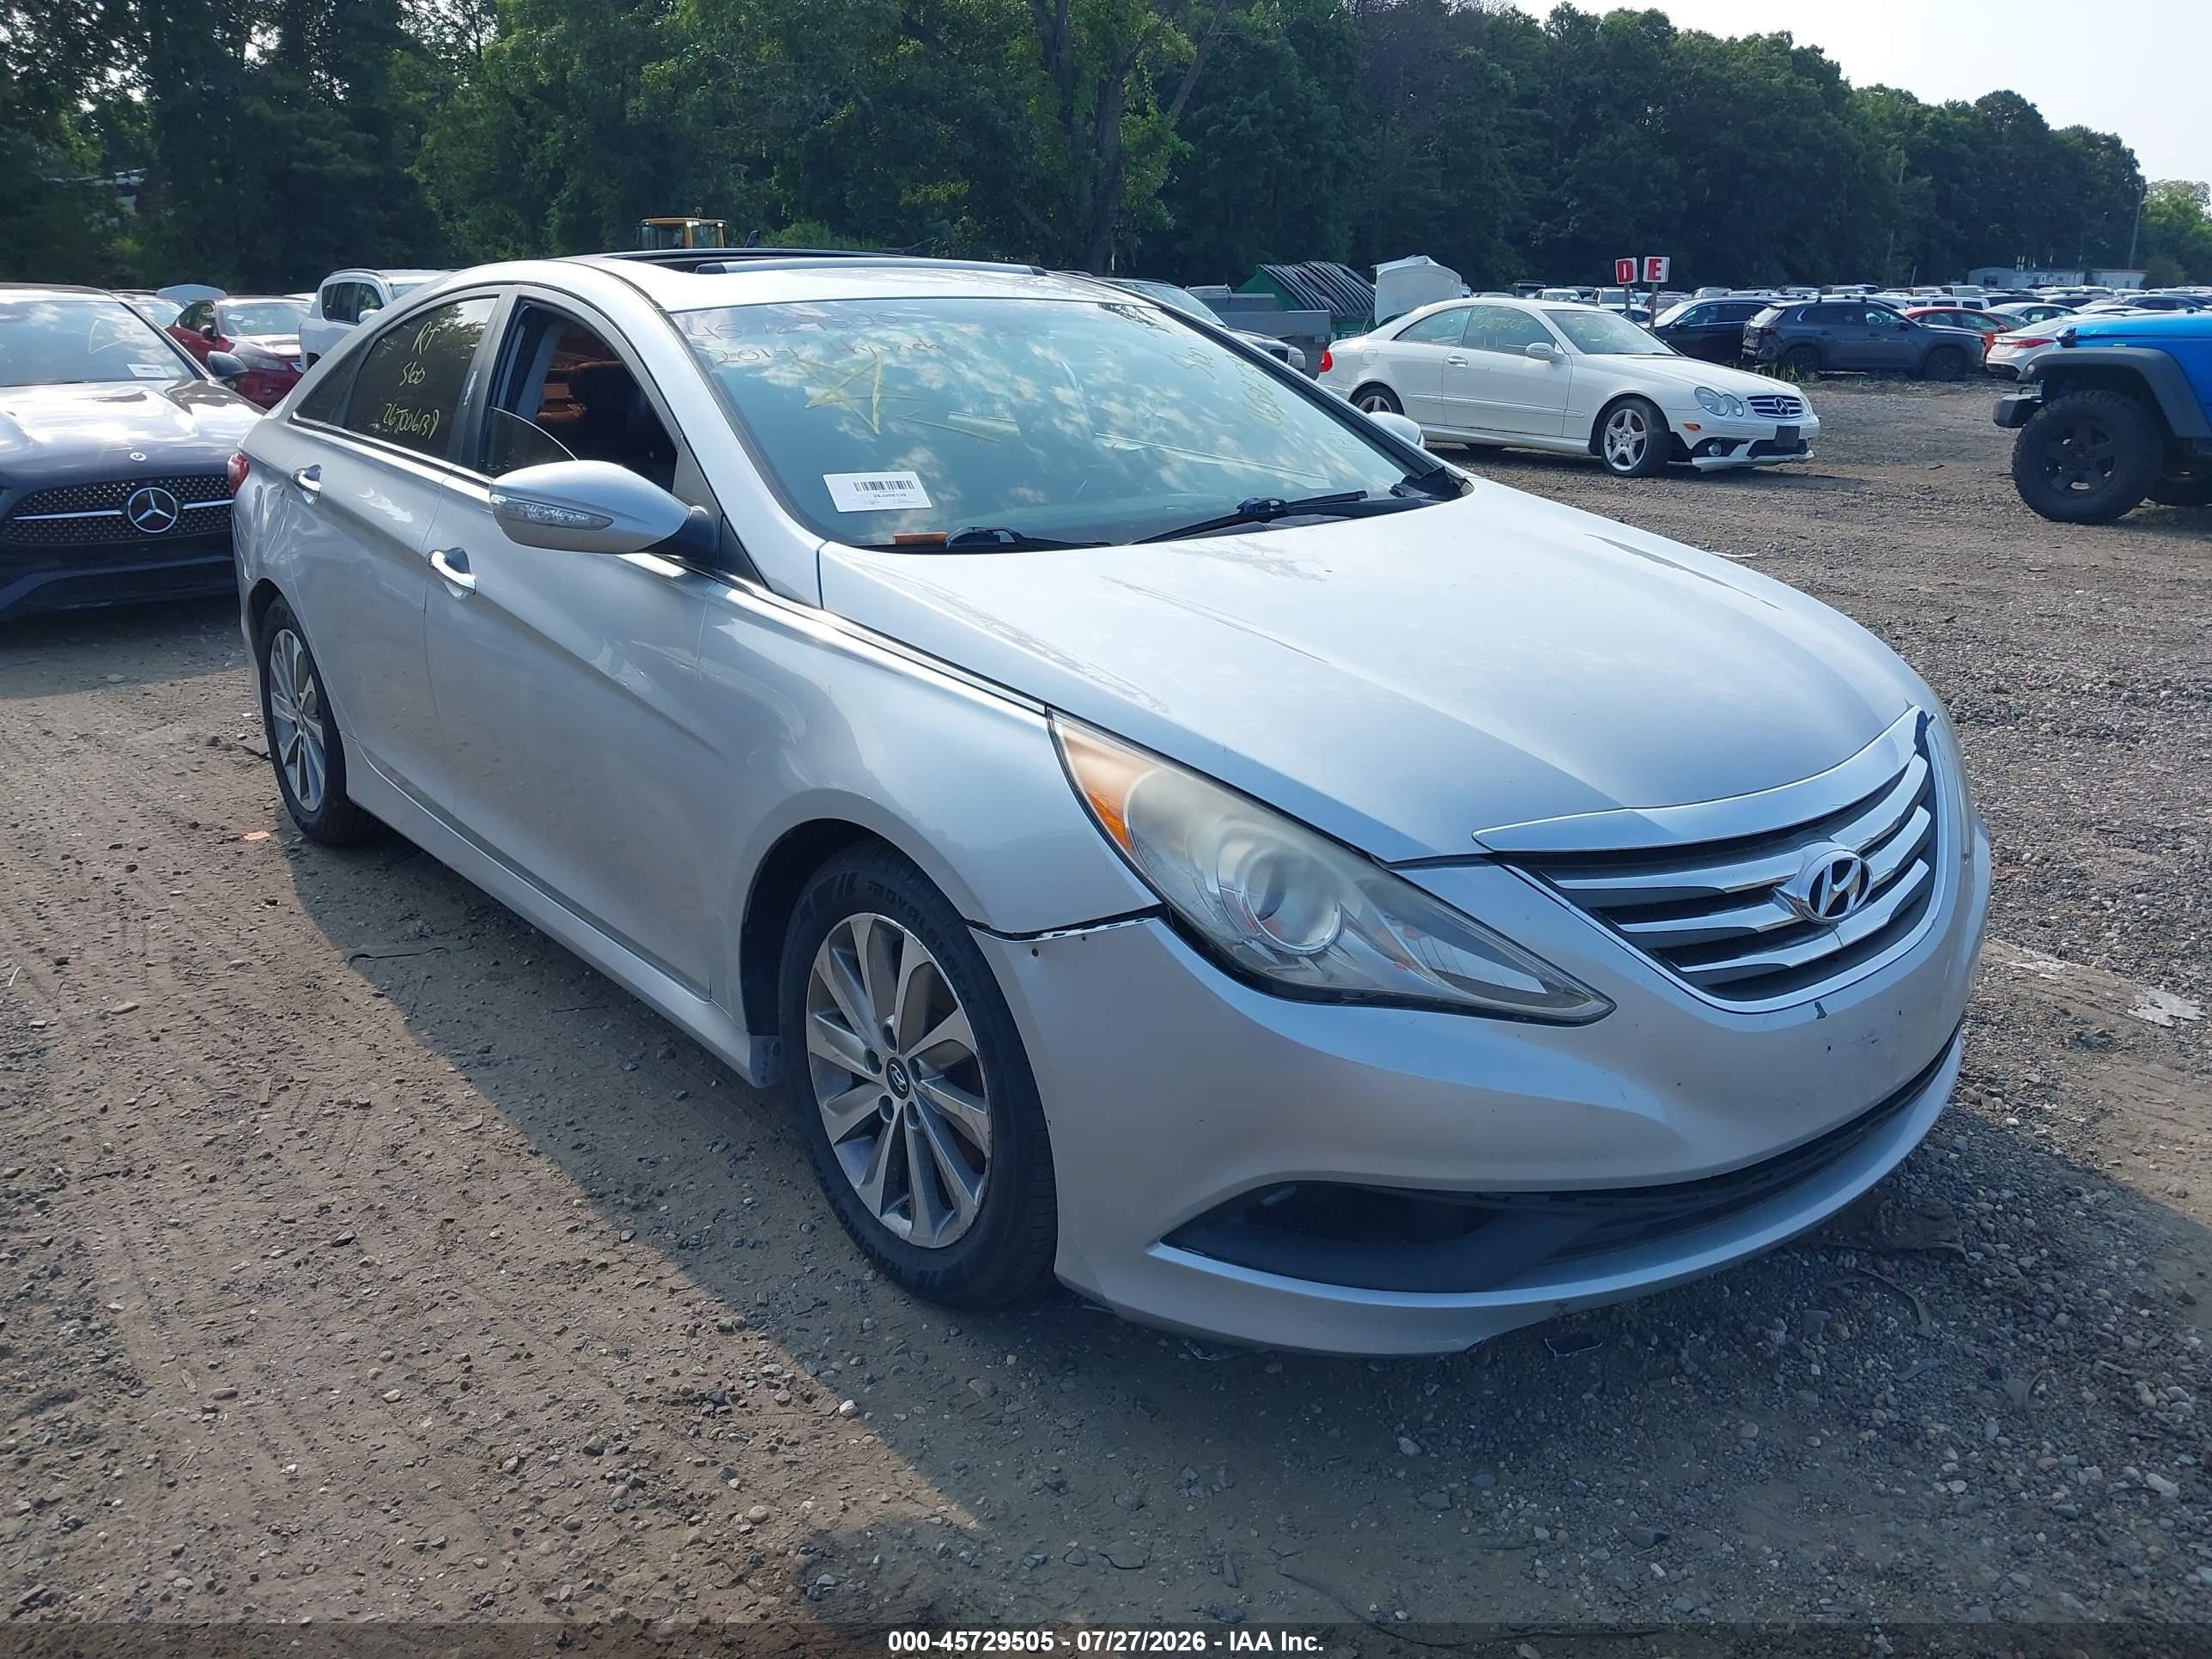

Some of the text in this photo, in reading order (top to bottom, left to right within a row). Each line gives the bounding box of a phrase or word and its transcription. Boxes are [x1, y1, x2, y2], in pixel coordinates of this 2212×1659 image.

[1617, 260, 1634, 283] D
[1647, 258, 1662, 281] E
[411, 321, 441, 356] RT
